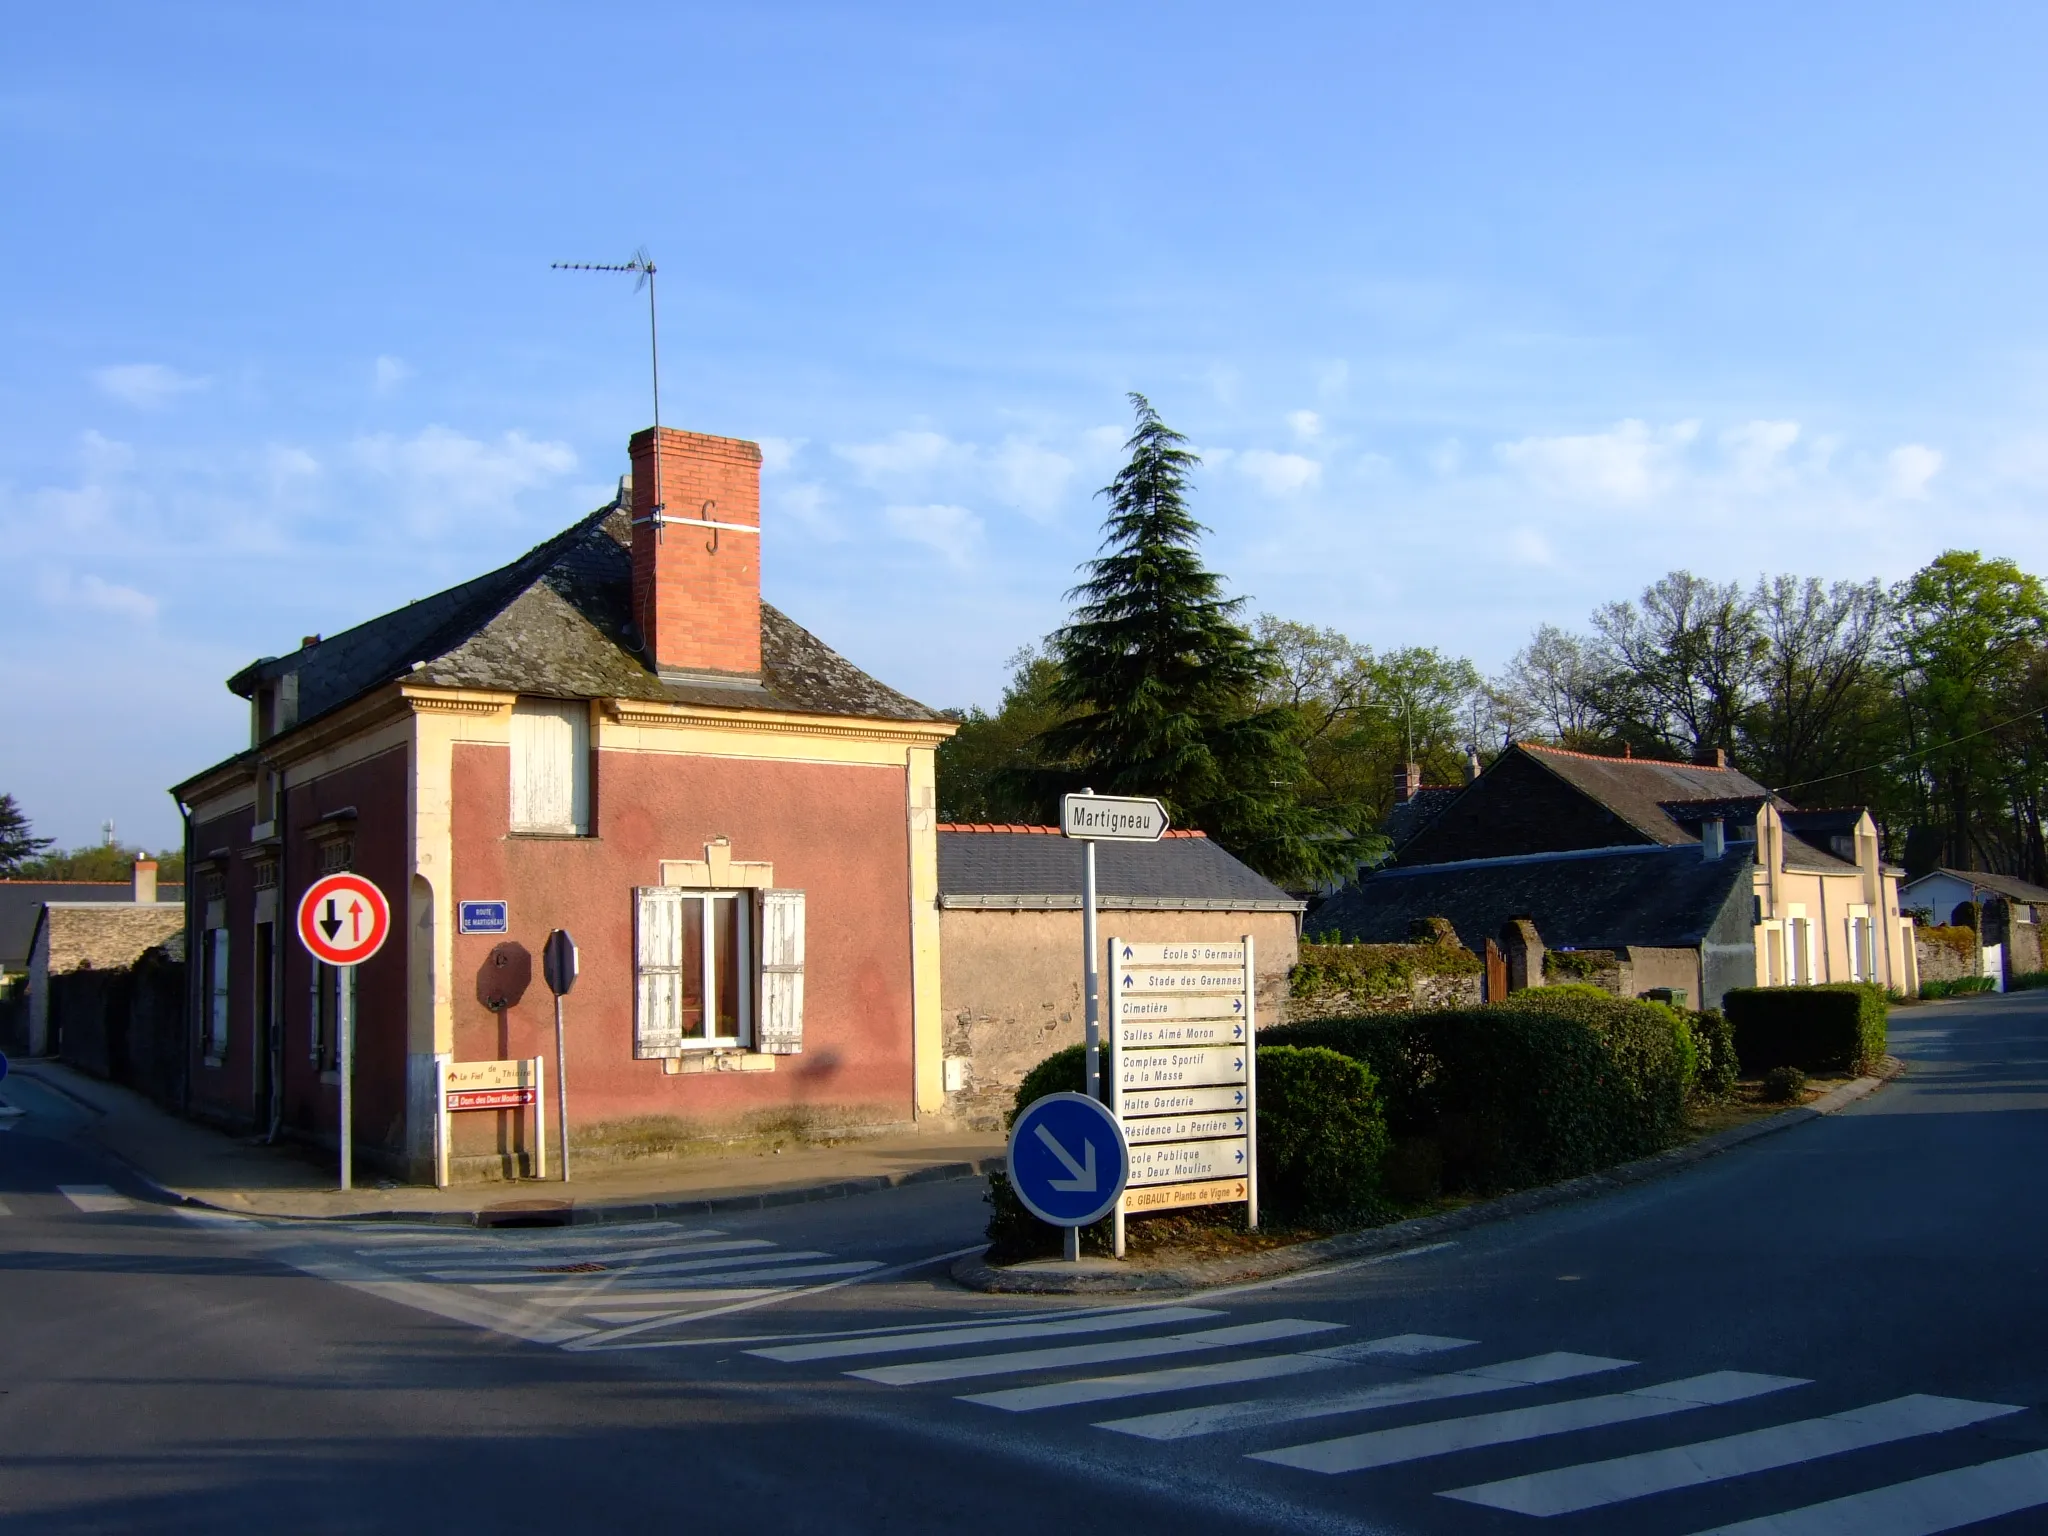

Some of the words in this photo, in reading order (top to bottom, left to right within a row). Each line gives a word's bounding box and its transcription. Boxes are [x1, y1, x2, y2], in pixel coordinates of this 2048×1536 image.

[1073, 806, 1151, 833] Martigneau
[1163, 946, 1189, 959] École
[1205, 948, 1242, 959] Germain
[1148, 976, 1175, 986] Stade
[1181, 976, 1196, 986] des
[1201, 975, 1242, 985] Garennes
[1122, 1003, 1168, 1014] Cimetière
[1123, 1030, 1153, 1041] Salles
[1158, 1029, 1182, 1040] Aimé
[1186, 1028, 1214, 1039] Moron
[1123, 1056, 1167, 1069] Complexe
[1172, 1053, 1205, 1067] Sportif
[460, 1072, 467, 1081] Le
[470, 1071, 484, 1081] Fief
[488, 1065, 497, 1073] de
[495, 1076, 502, 1084] la
[1123, 1072, 1135, 1082] de
[1141, 1072, 1149, 1081] la
[1154, 1071, 1183, 1081] Masse
[501, 1094, 523, 1103] Moulins
[1124, 1099, 1149, 1110] Halte
[1154, 1096, 1194, 1108] Garderie
[1125, 1125, 1172, 1137] Résidence
[1176, 1123, 1186, 1133] La
[1191, 1121, 1227, 1132] Perrière
[1131, 1154, 1152, 1164] cole
[1157, 1150, 1200, 1162] Publique
[1147, 1166, 1170, 1177] Deux
[1175, 1163, 1212, 1174] Moulins
[1126, 1196, 1134, 1206] G.
[1137, 1192, 1170, 1205] GIBAULT
[1174, 1190, 1196, 1202] Plants
[1200, 1188, 1208, 1199] de
[1210, 1187, 1231, 1200] Vigne
